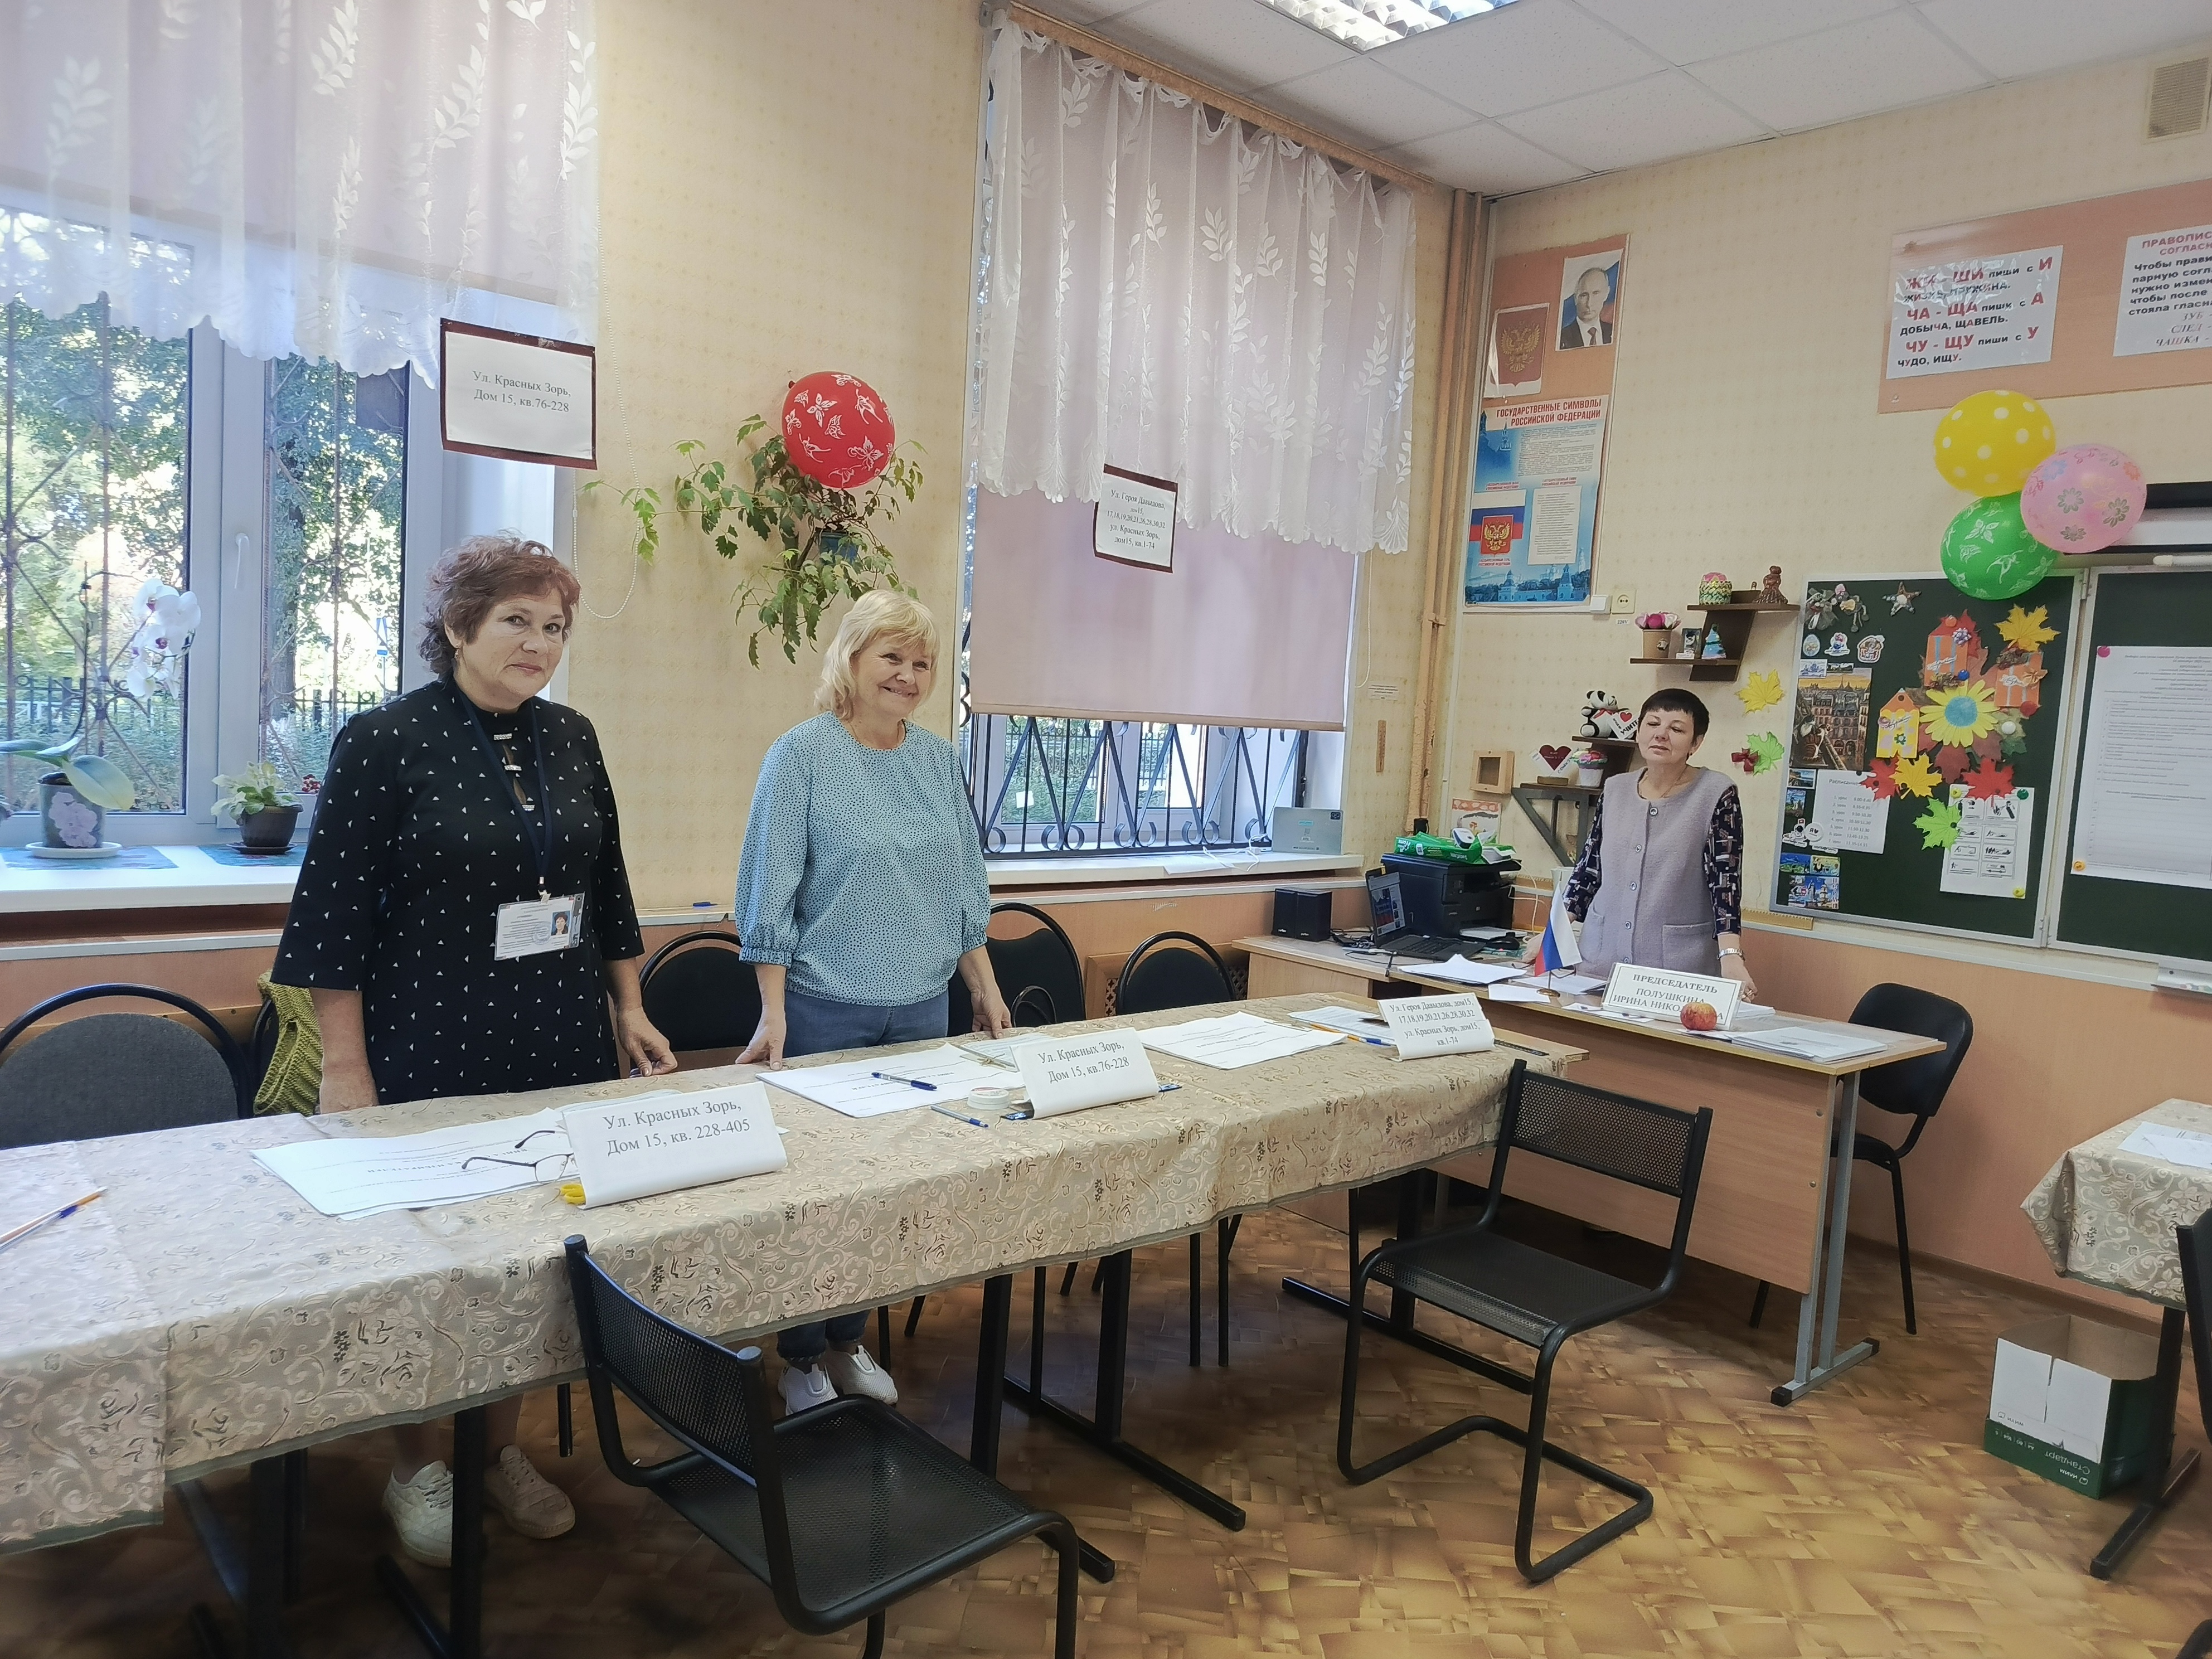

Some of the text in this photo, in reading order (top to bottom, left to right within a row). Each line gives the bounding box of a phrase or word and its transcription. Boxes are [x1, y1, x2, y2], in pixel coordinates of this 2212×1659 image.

[2142, 231, 2212, 249] ПРАВОПИС
[2160, 242, 2212, 255] СОГЛАСН
[1953, 268, 1984, 283] ШИ
[1989, 268, 2019, 278] пиши
[2039, 256, 2053, 270] И
[2135, 256, 2212, 270] Чтобы прави
[2132, 267, 2212, 283] парную согл
[2132, 279, 2212, 294] нужно измен
[2130, 290, 2208, 304] чтобы после
[1907, 308, 1930, 321] ЧА
[1947, 302, 1978, 317] ЩА
[1982, 302, 2012, 312] пиши
[2031, 292, 2044, 305] А
[2129, 306, 2170, 315] стояла
[1900, 316, 2008, 337] ДОБЫЧА, ЩАВЕЛЬ.
[1906, 339, 1928, 353] ЧУ
[1945, 334, 1975, 350] ЩУ
[1978, 336, 2008, 346] пиши
[2027, 326, 2039, 339] У
[1898, 353, 1962, 367] ЧУДО, ИЩУ.
[473, 371, 571, 397] Ул. Красных Зорь,
[474, 390, 569, 412] Дом 15, кв.76-228
[1497, 399, 1602, 418] ГОСУДАРСТВЕННЫЕ СИМВОЛЫ
[1511, 409, 1600, 426] РОССИЙСКОЙ ФЕДЕРАЦИИ
[1110, 489, 1166, 510] Ул. Героя Давыдова,
[1114, 537, 1134, 546] дом15,
[1120, 525, 1144, 536] Красных
[1146, 530, 1160, 540] Зорь,
[1620, 719, 1639, 735] УЧИТЕ
[1633, 974, 1718, 994] ПРЕДСЕДАТЕЛЬ
[1636, 988, 1705, 1003] ПОЛУШКИНА
[1389, 1004, 1402, 1012] Ул.
[1403, 1003, 1420, 1012] Героя
[1421, 1001, 1453, 1011] Давыдова,
[1613, 995, 1723, 1020] ИРИНА НИКОА
[1404, 1030, 1414, 1039] ул.
[1414, 1027, 1442, 1037] Красных
[1443, 1025, 1459, 1035] Зорь,
[1037, 1041, 1124, 1064] Ул. Красных Зорь,
[1047, 1056, 1130, 1084] Дом 15, кв.76-228
[603, 1100, 741, 1129] Ул. Красных Зорь,
[607, 1119, 750, 1157] Дом 15, кв. 228-405
[2045, 1451, 2090, 1475] Стандарт
